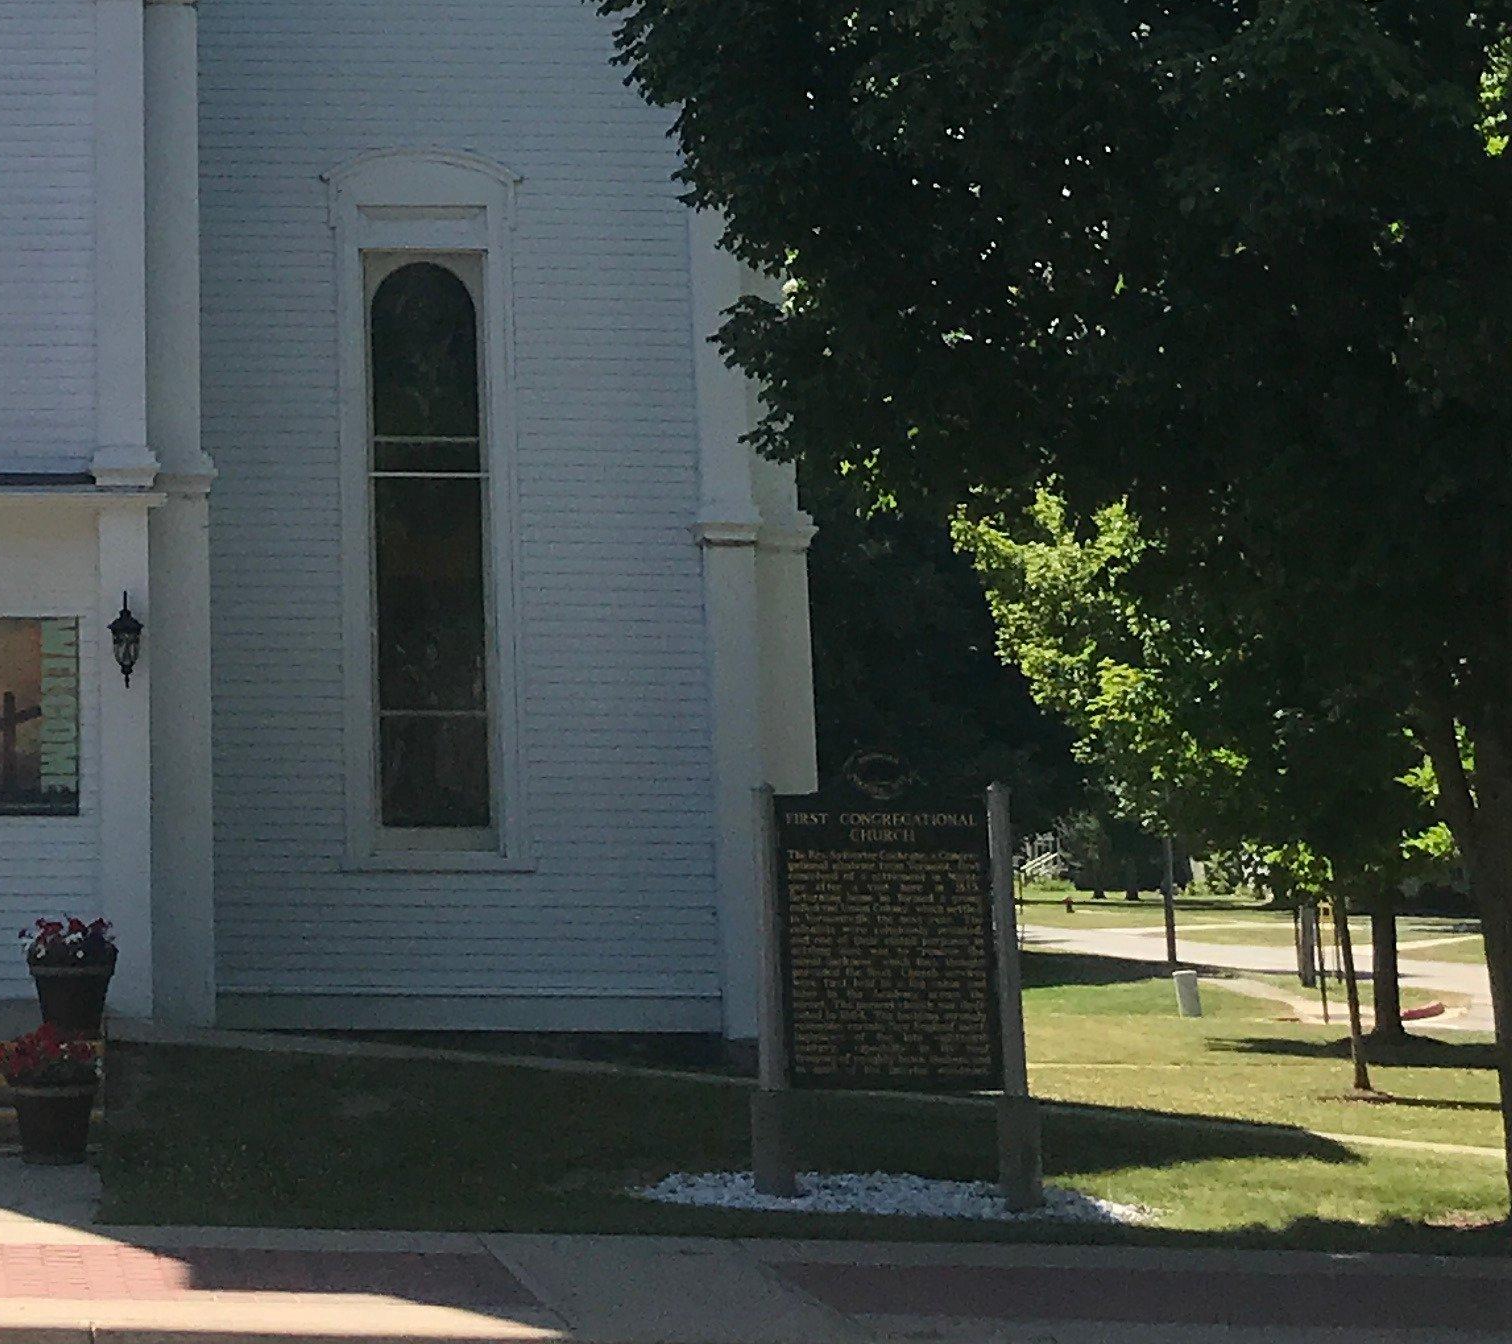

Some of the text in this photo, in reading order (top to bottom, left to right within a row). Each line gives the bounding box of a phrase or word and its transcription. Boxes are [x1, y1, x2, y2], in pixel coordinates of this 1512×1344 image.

[40, 620, 78, 793] WELCOME
[786, 812, 977, 827] FIRST CONGREGATIONAL
[849, 828, 916, 842] CHURCH
